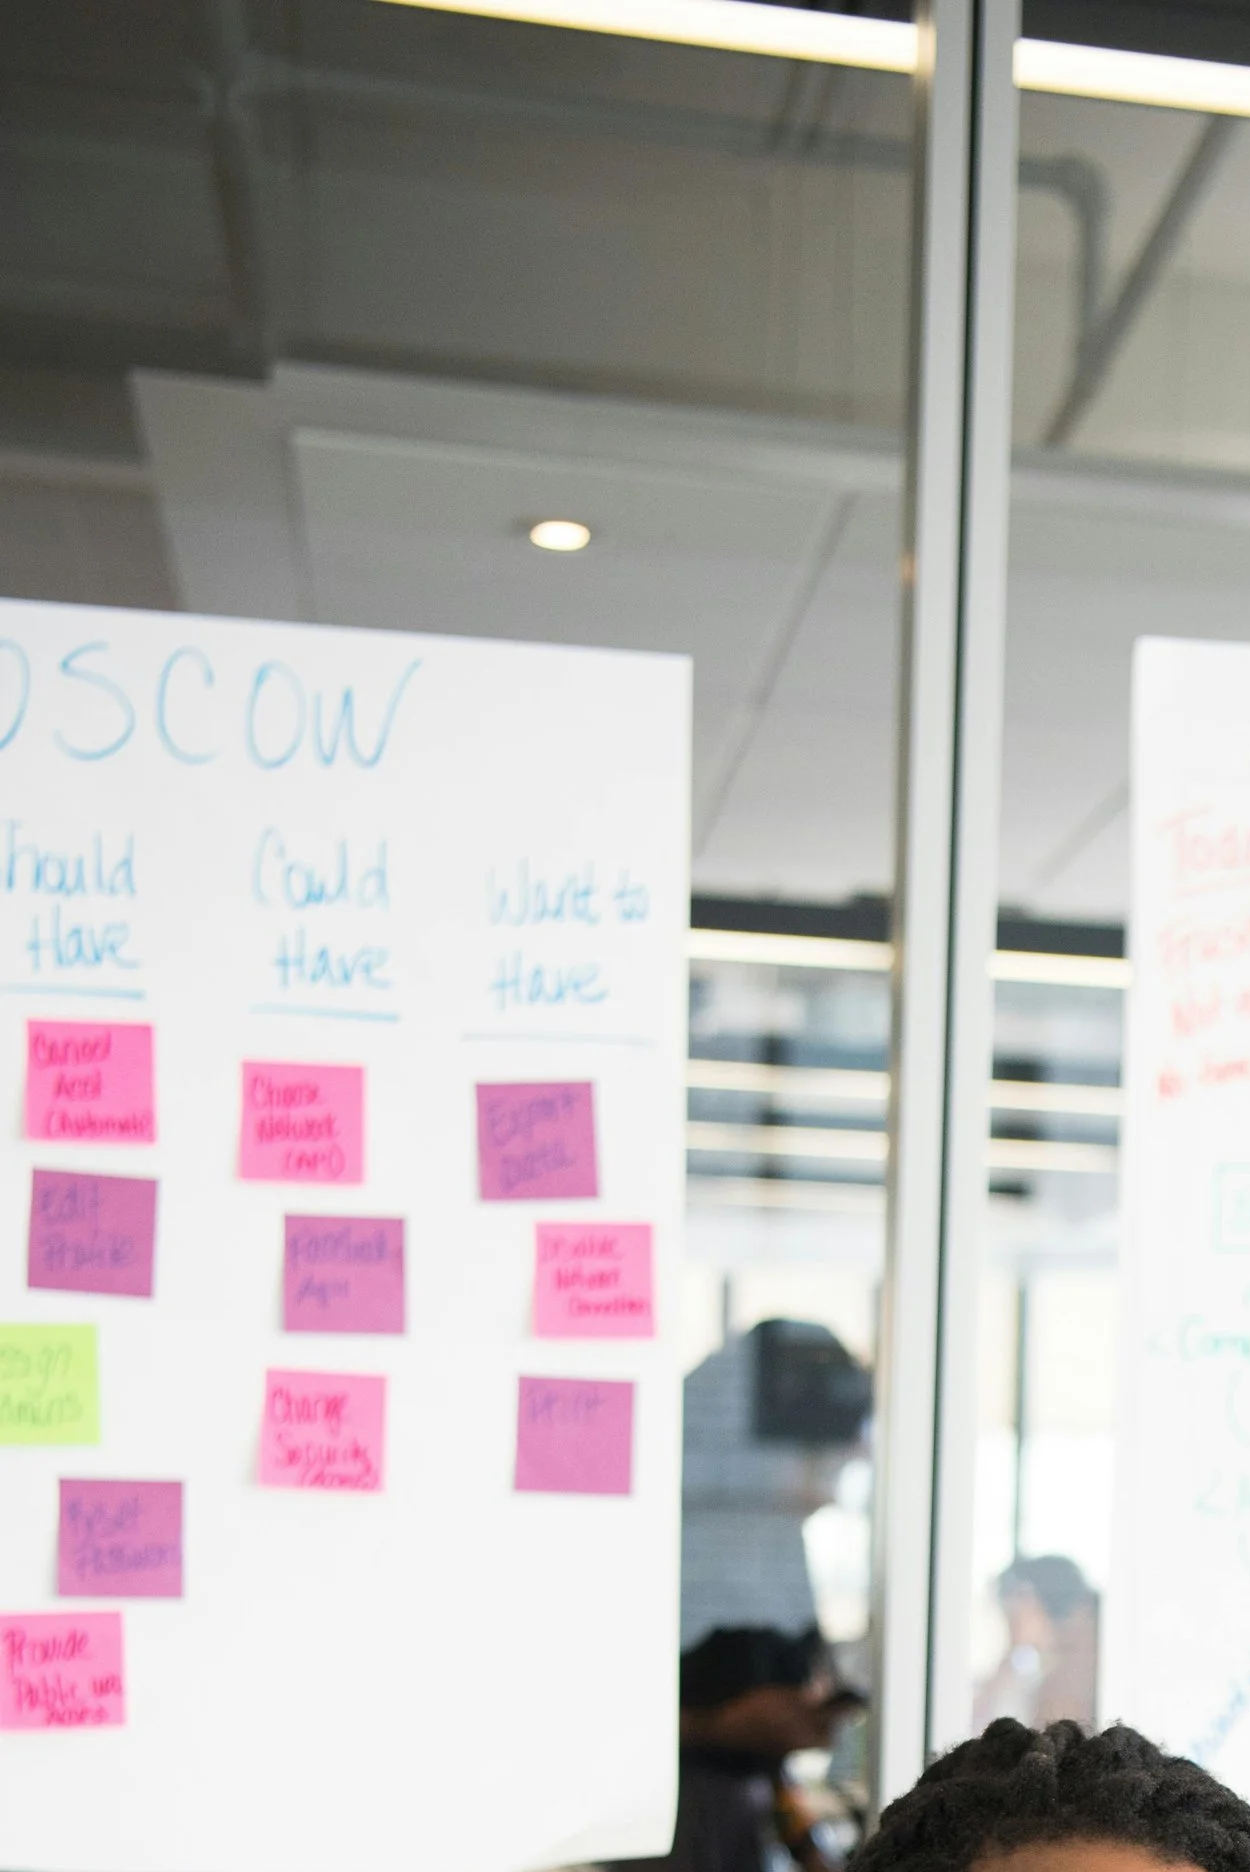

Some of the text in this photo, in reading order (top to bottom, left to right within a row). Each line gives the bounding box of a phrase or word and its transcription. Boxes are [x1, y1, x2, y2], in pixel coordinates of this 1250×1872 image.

[0, 818, 138, 898] hould
[251, 825, 392, 910] Could
[485, 857, 651, 926] Want to
[26, 902, 143, 976] Have
[272, 924, 394, 991] Have
[488, 950, 610, 1012] Have
